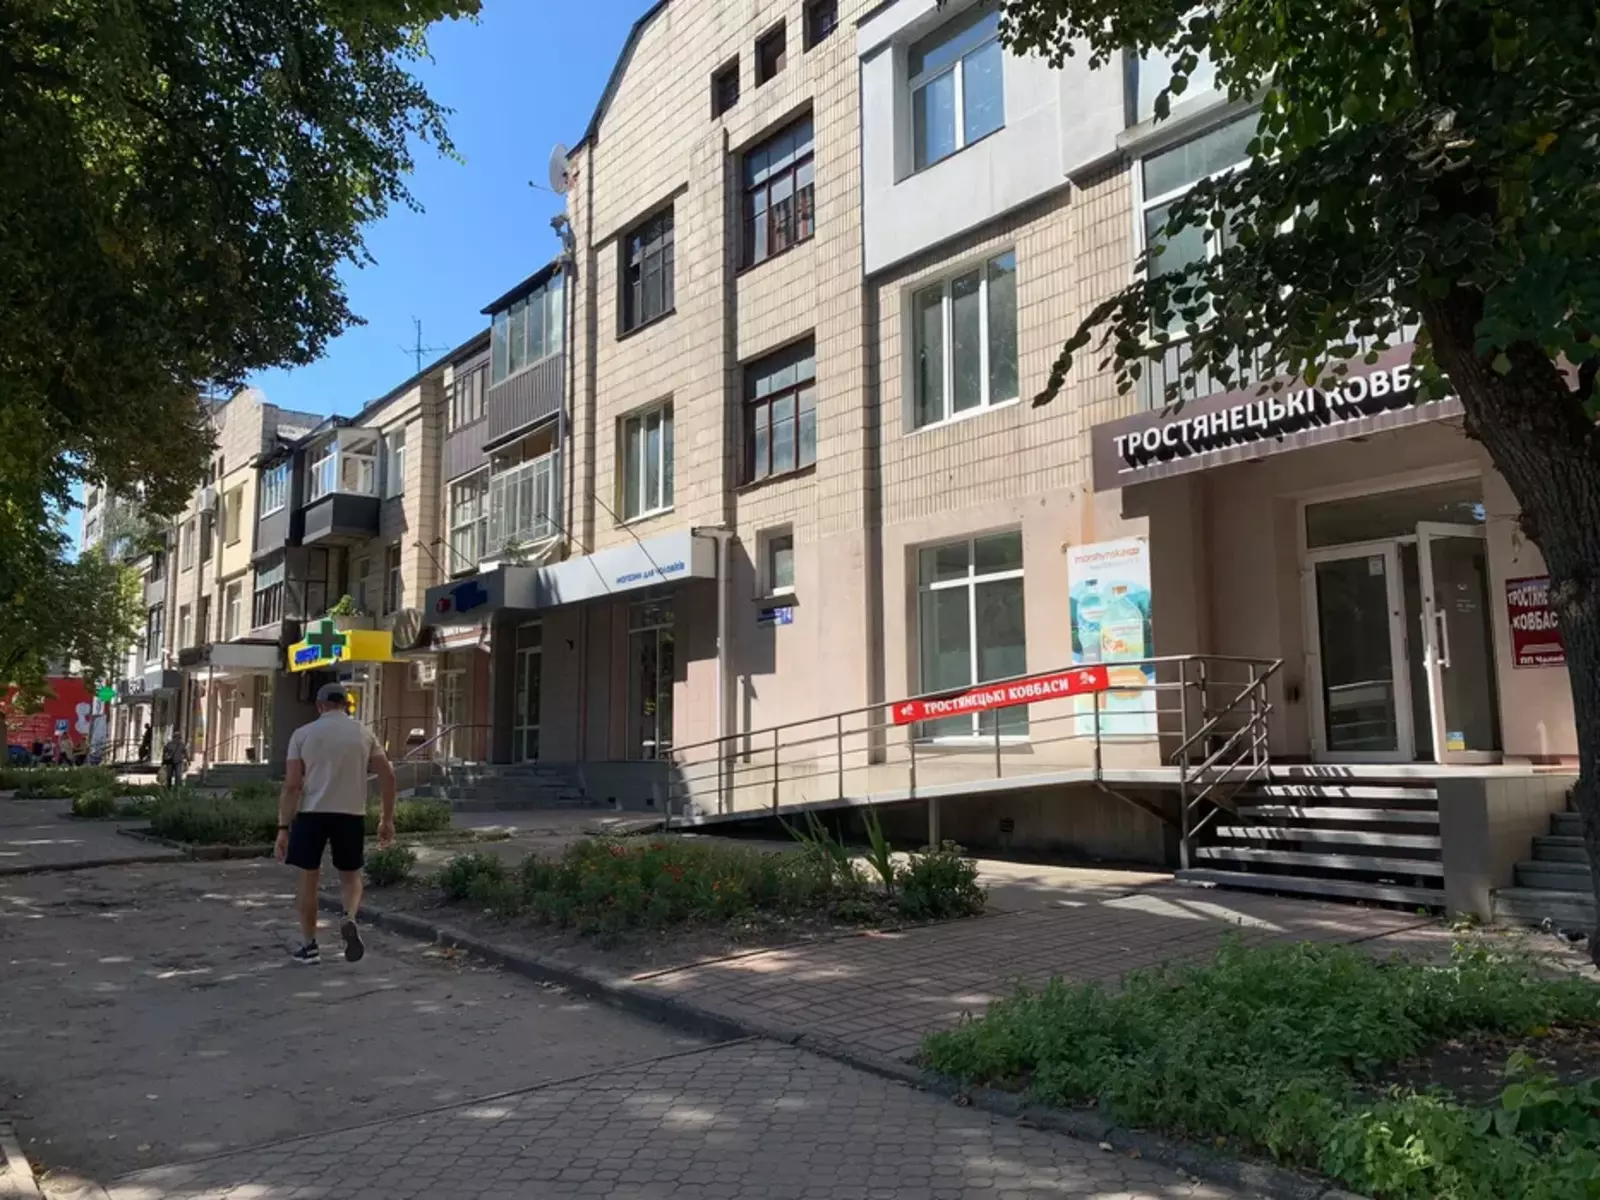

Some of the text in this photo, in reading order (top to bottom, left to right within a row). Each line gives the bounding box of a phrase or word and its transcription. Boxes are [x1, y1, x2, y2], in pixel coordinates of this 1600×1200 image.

[1112, 362, 1425, 458] ТРОСТЯНЕЦЬКІ КОВБ
[1512, 611, 1559, 630] КОВБАС
[923, 678, 1069, 715] ТРОСТЯНЕЦЬКІ КОВБАСИ
